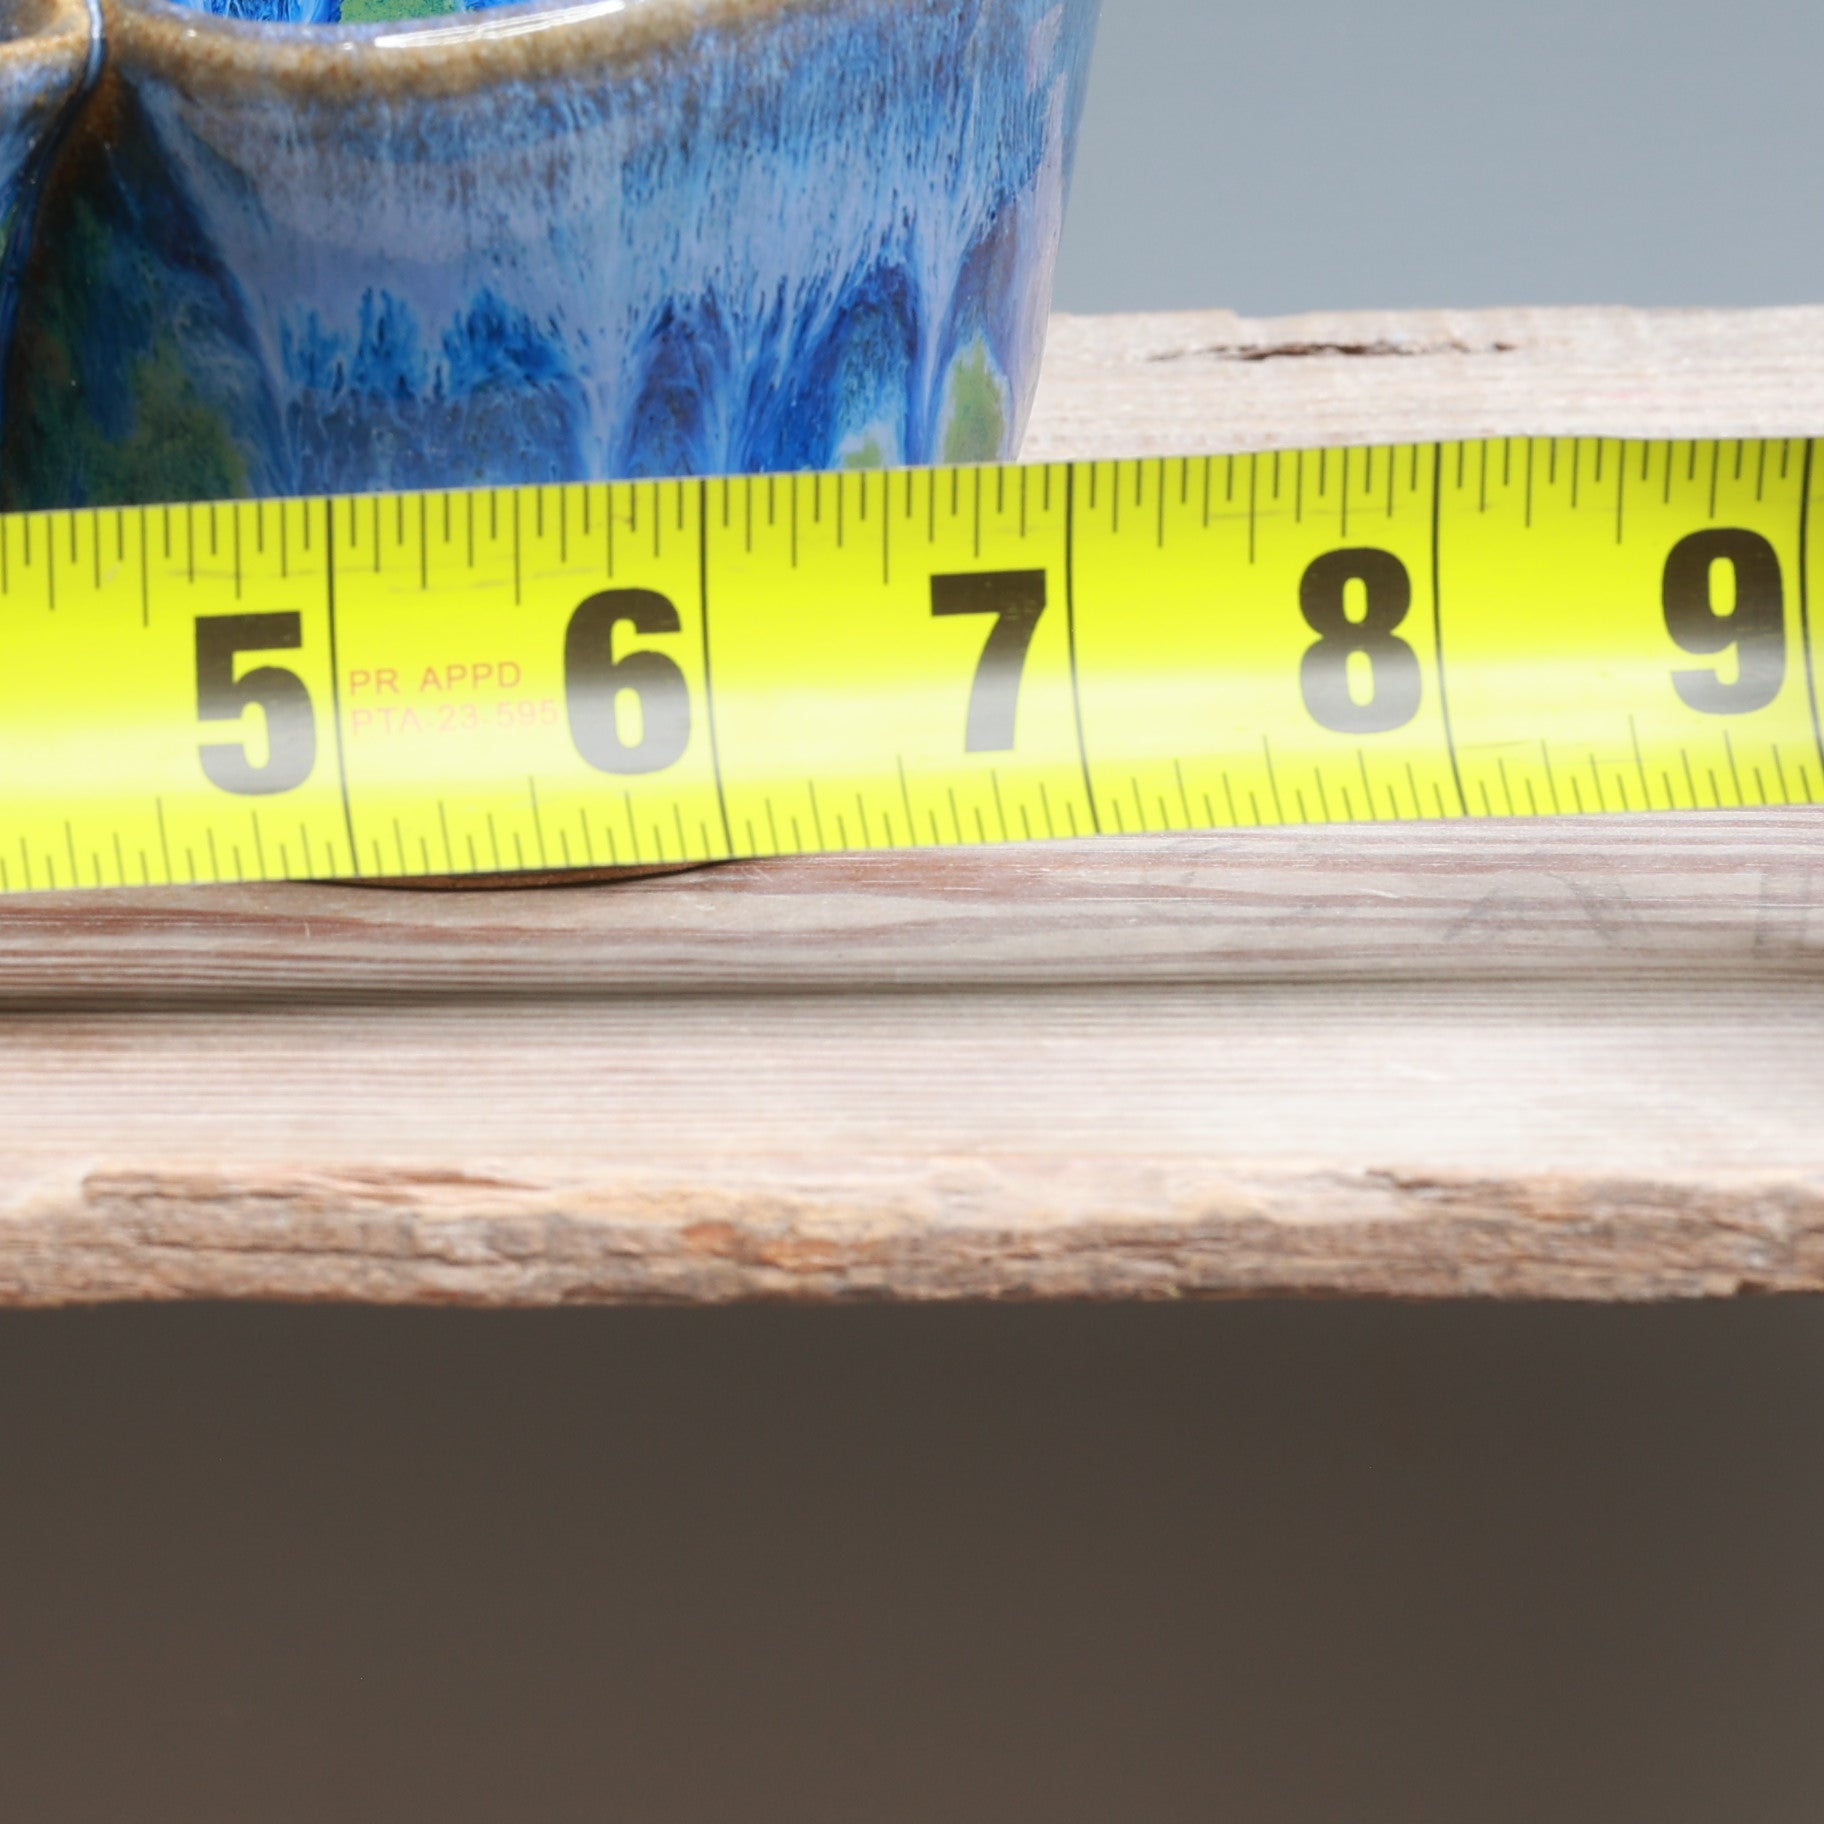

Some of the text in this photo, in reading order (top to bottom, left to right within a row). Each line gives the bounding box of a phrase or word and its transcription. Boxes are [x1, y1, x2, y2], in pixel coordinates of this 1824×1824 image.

[193, 610, 317, 796] 5
[349, 660, 523, 696] PR APPD
[563, 586, 691, 775] 6
[929, 567, 1047, 753] 7
[1298, 545, 1422, 734] 8
[1661, 526, 1786, 716] 9
